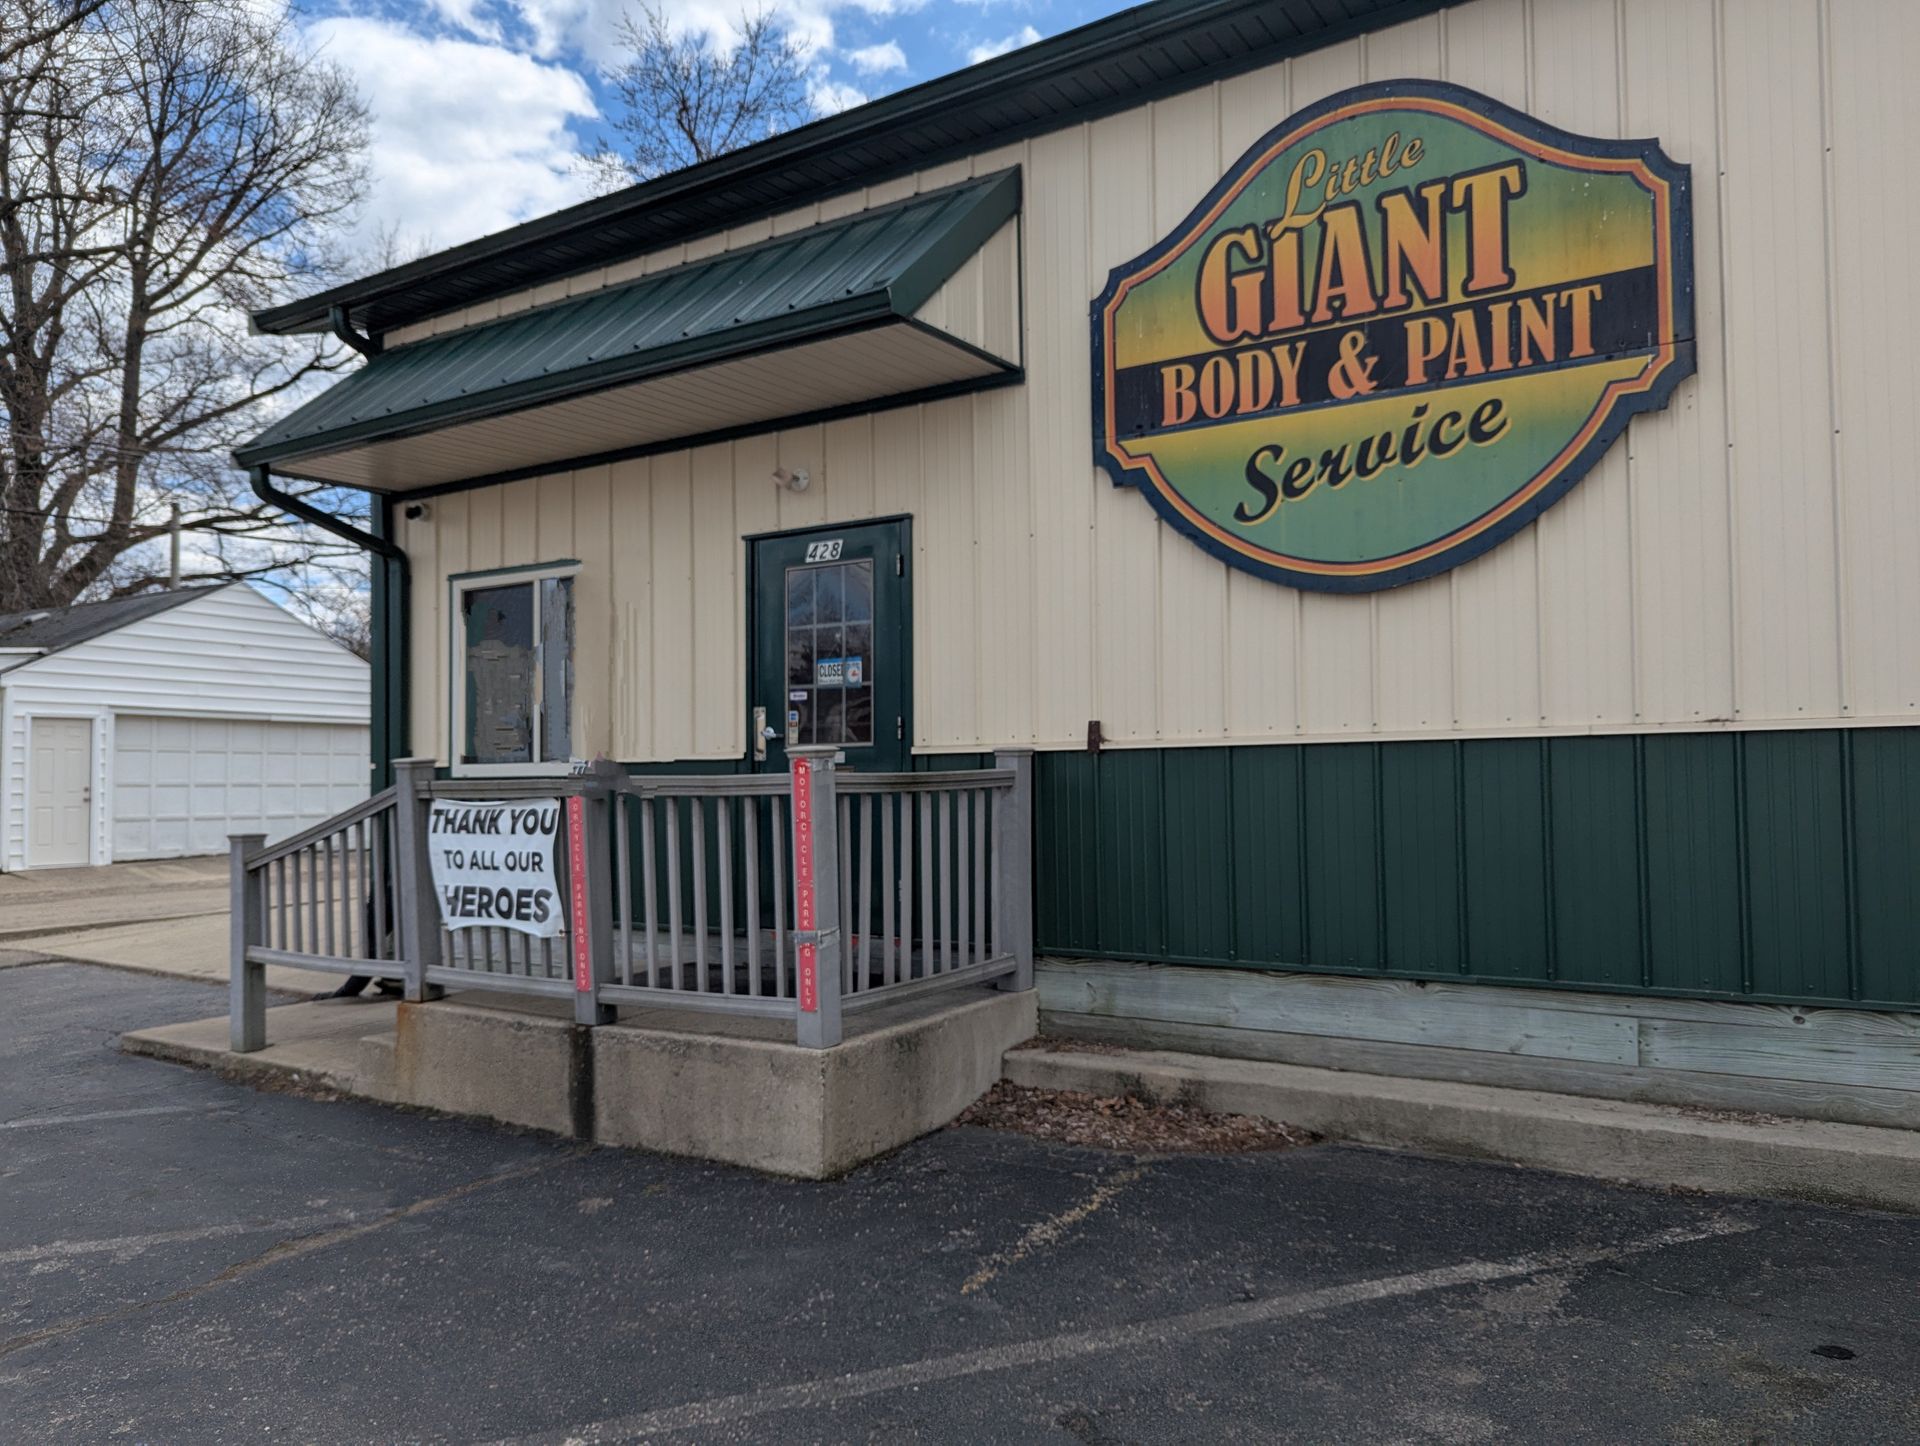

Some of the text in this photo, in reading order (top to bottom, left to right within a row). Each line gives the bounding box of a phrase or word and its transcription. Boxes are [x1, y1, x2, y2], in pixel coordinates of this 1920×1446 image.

[1270, 132, 1426, 235] Little
[1198, 162, 1526, 345] GIANT
[1160, 284, 1603, 428] BODY & PAINT
[1233, 397, 1511, 524] Service
[808, 541, 841, 561] 428
[431, 808, 558, 836] THANK YOU
[444, 850, 544, 872] TO ALL OUR
[798, 766, 812, 1005] MOTORCYCLE PARKG ONLY
[444, 885, 554, 923] HEROES
[576, 883, 585, 944] PARKING
[578, 951, 587, 987] ONLY
